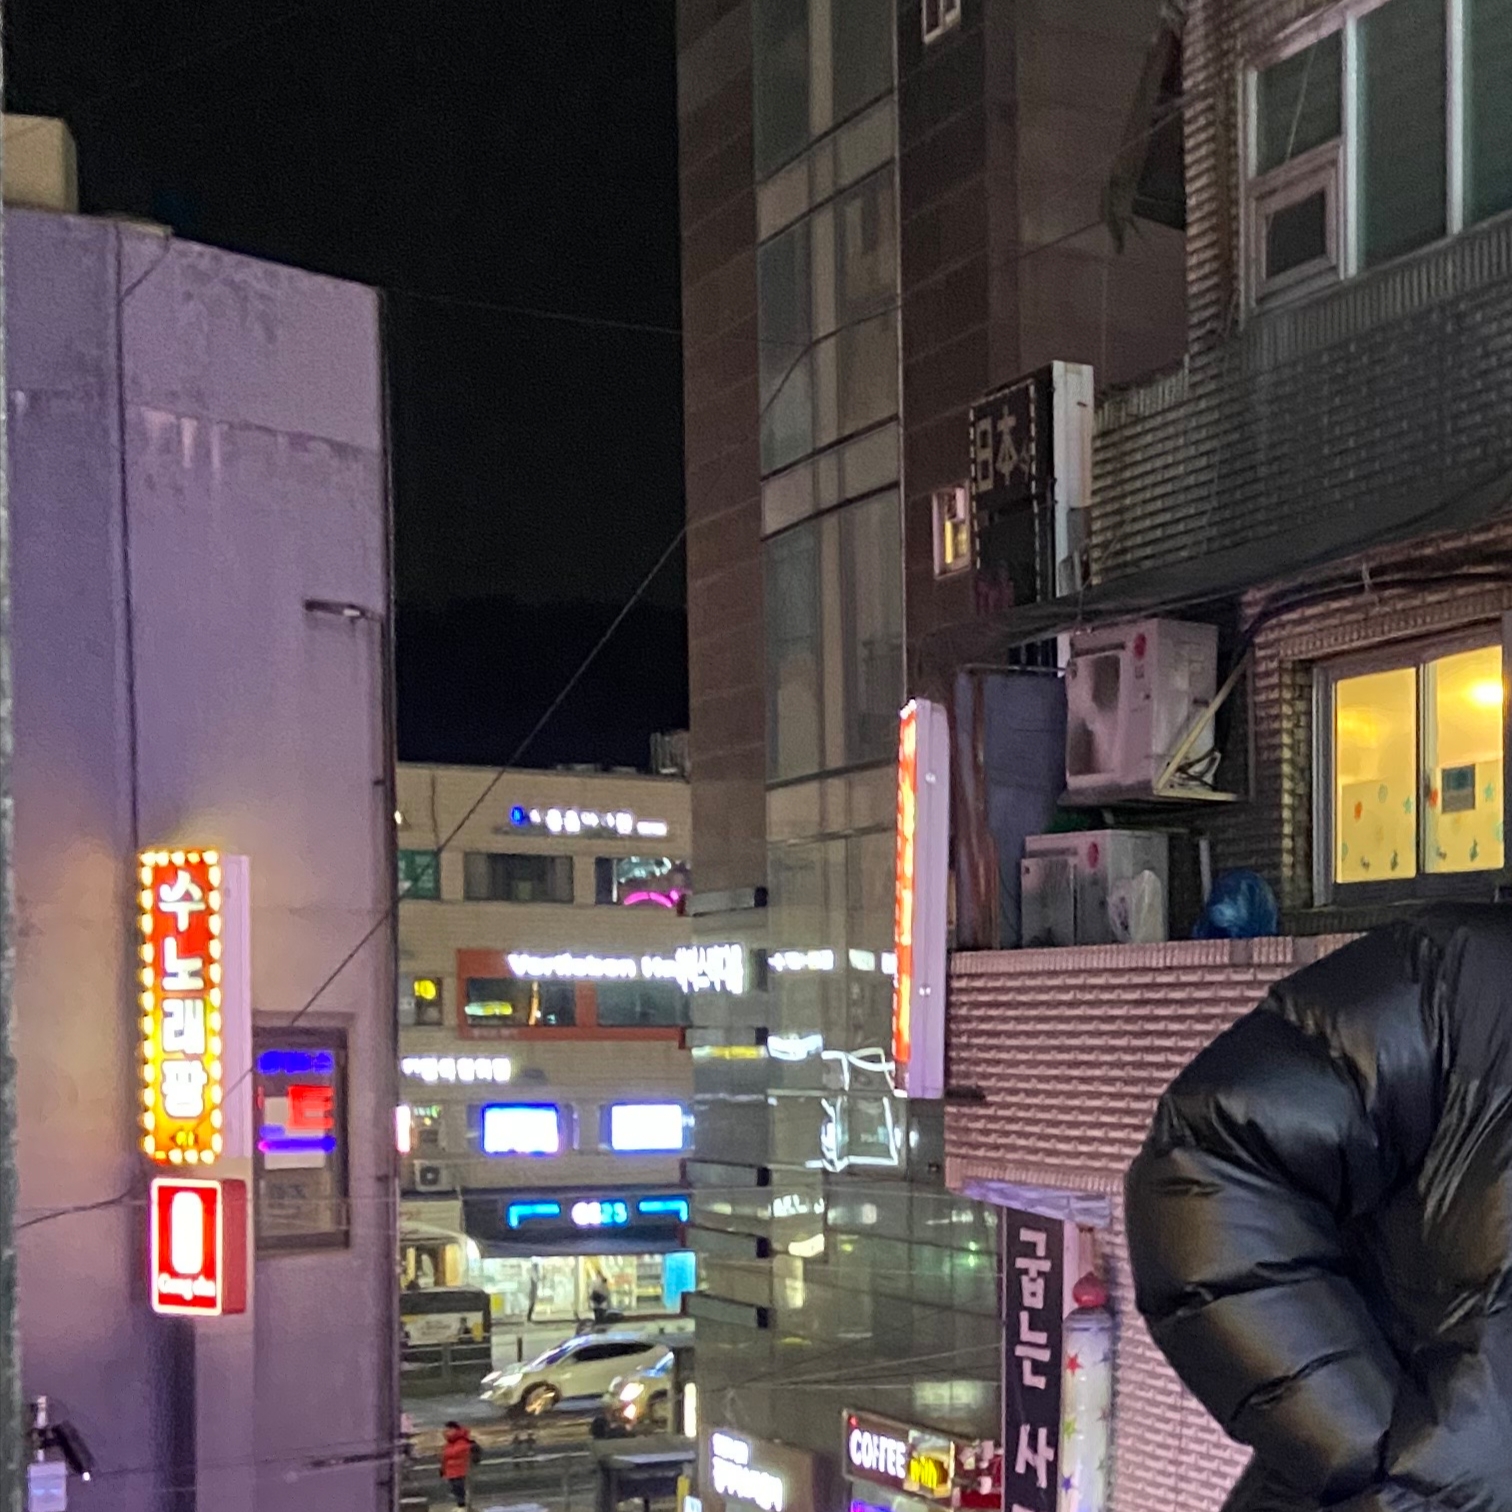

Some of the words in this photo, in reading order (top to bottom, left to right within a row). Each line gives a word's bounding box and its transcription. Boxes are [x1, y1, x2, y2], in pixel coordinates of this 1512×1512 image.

[158, 869, 208, 1118] 수노래방
[1015, 1227, 1051, 1390] 굽는
[849, 1428, 906, 1479] COFFEE
